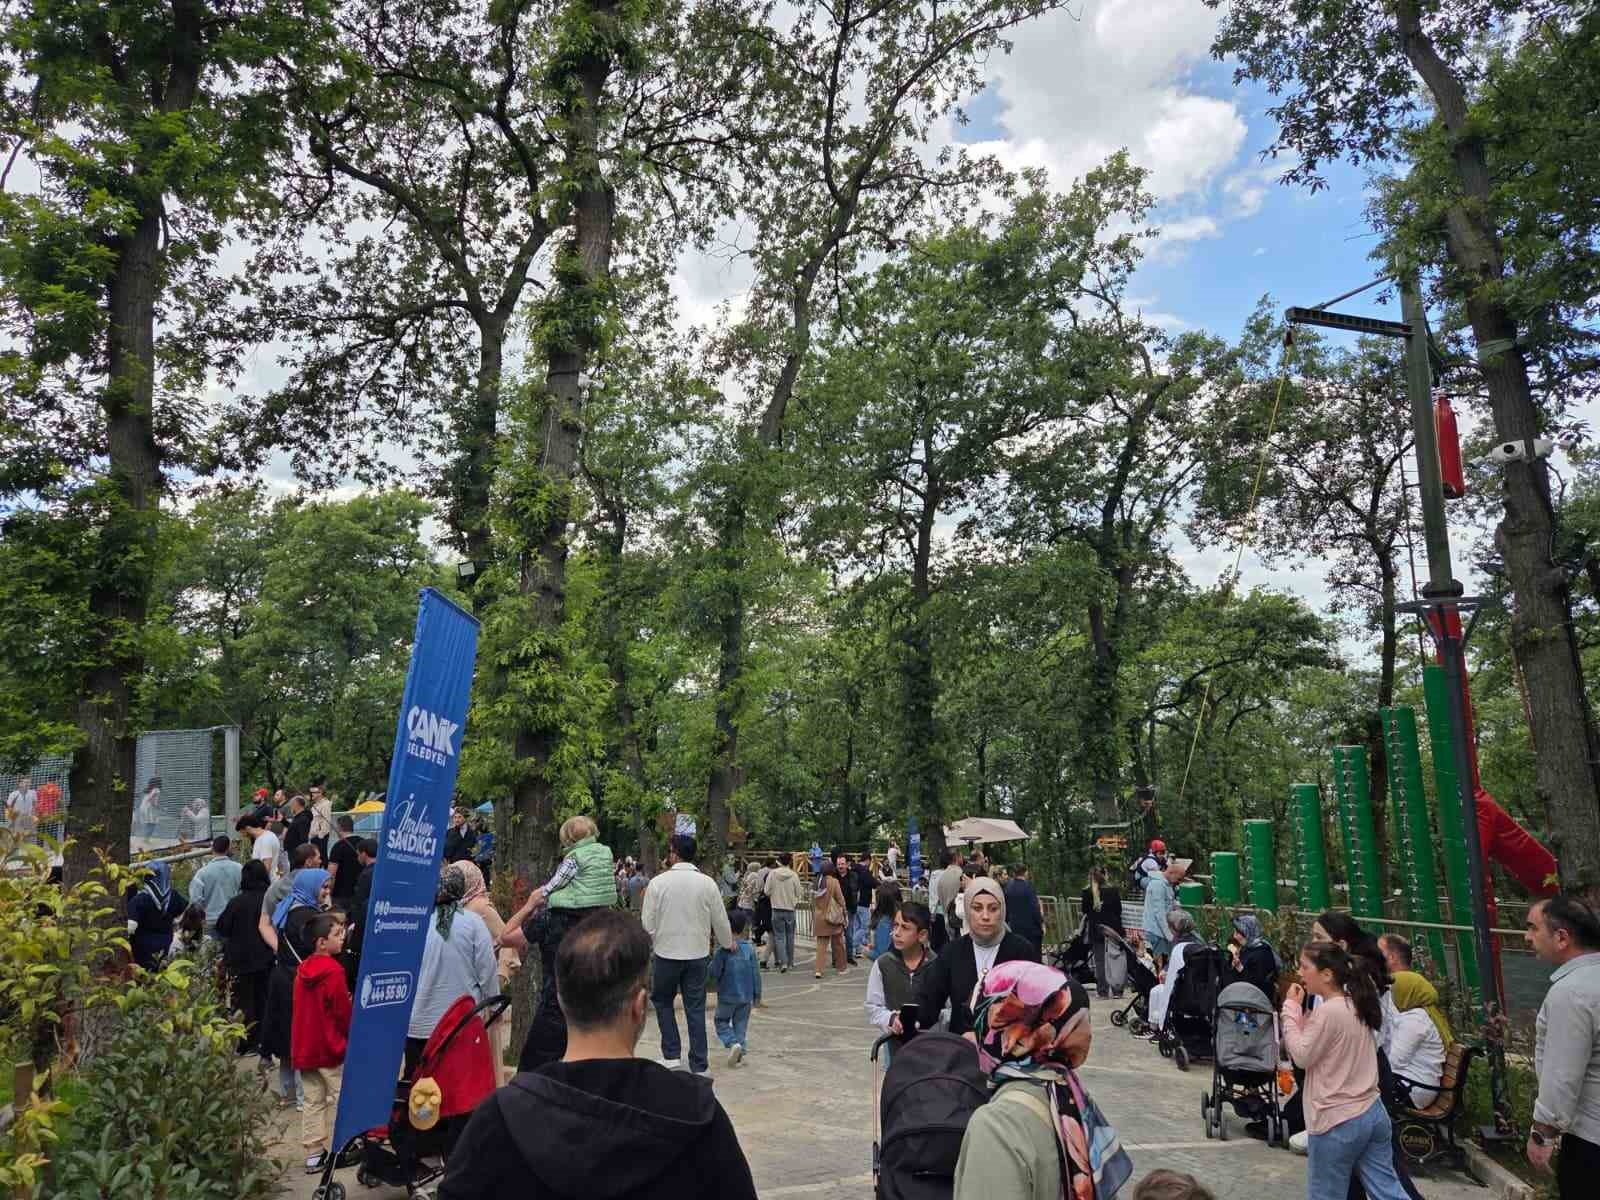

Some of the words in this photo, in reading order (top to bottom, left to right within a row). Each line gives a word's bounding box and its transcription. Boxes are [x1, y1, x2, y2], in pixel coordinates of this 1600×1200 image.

[371, 986, 385, 1002] 444
[385, 985, 396, 1000] 55
[395, 984, 407, 999] 90
